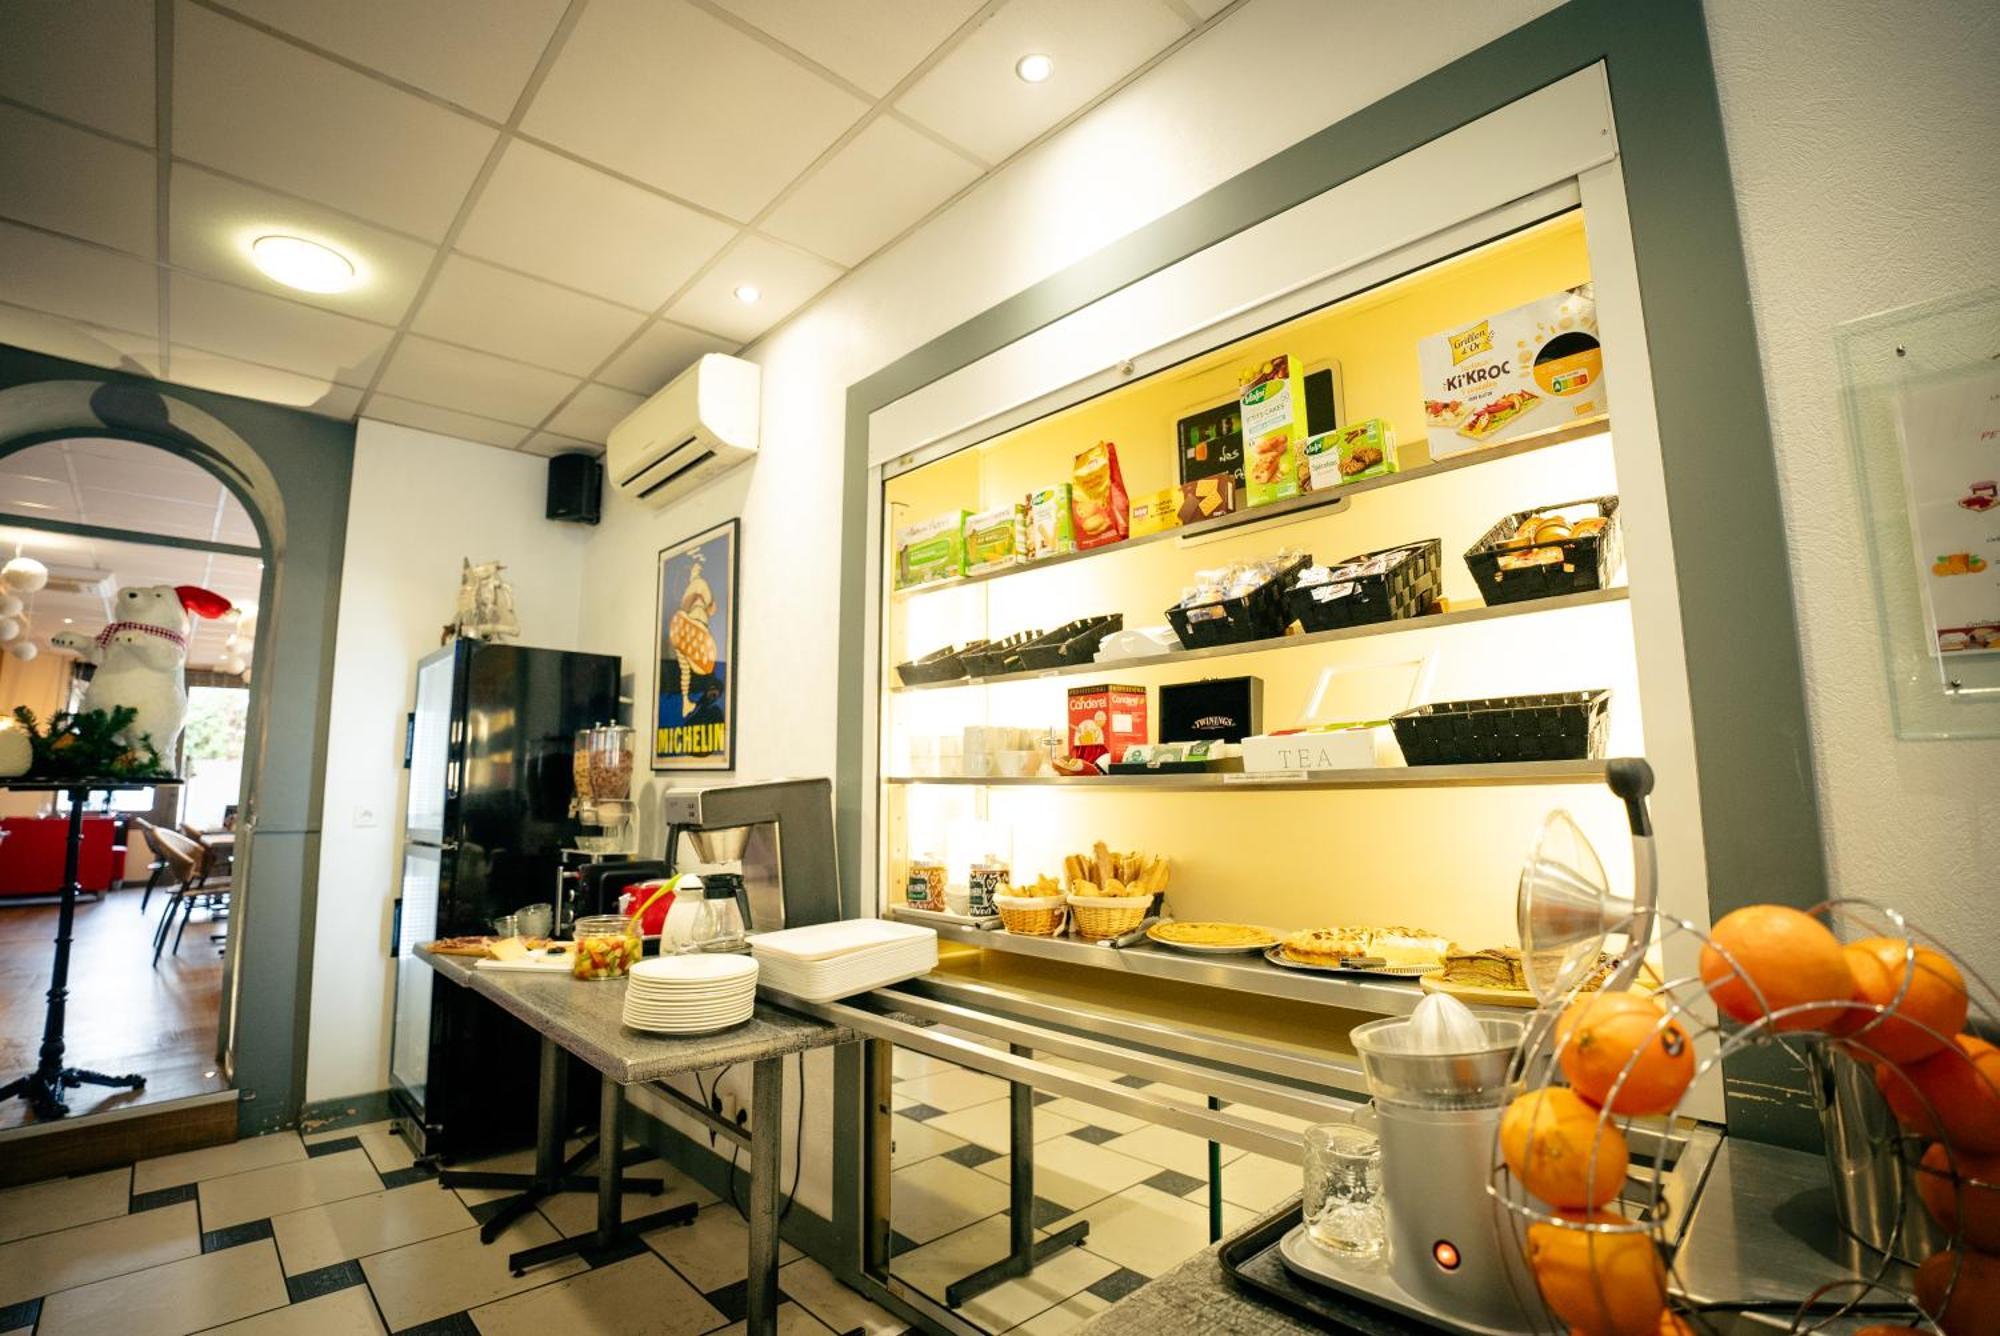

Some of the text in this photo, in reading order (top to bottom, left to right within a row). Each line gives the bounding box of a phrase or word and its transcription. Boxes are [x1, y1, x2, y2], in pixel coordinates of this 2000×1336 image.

[1194, 716, 1234, 729] TWININGS
[657, 722, 726, 753] MICHELIN
[1278, 747, 1333, 769] TEA
